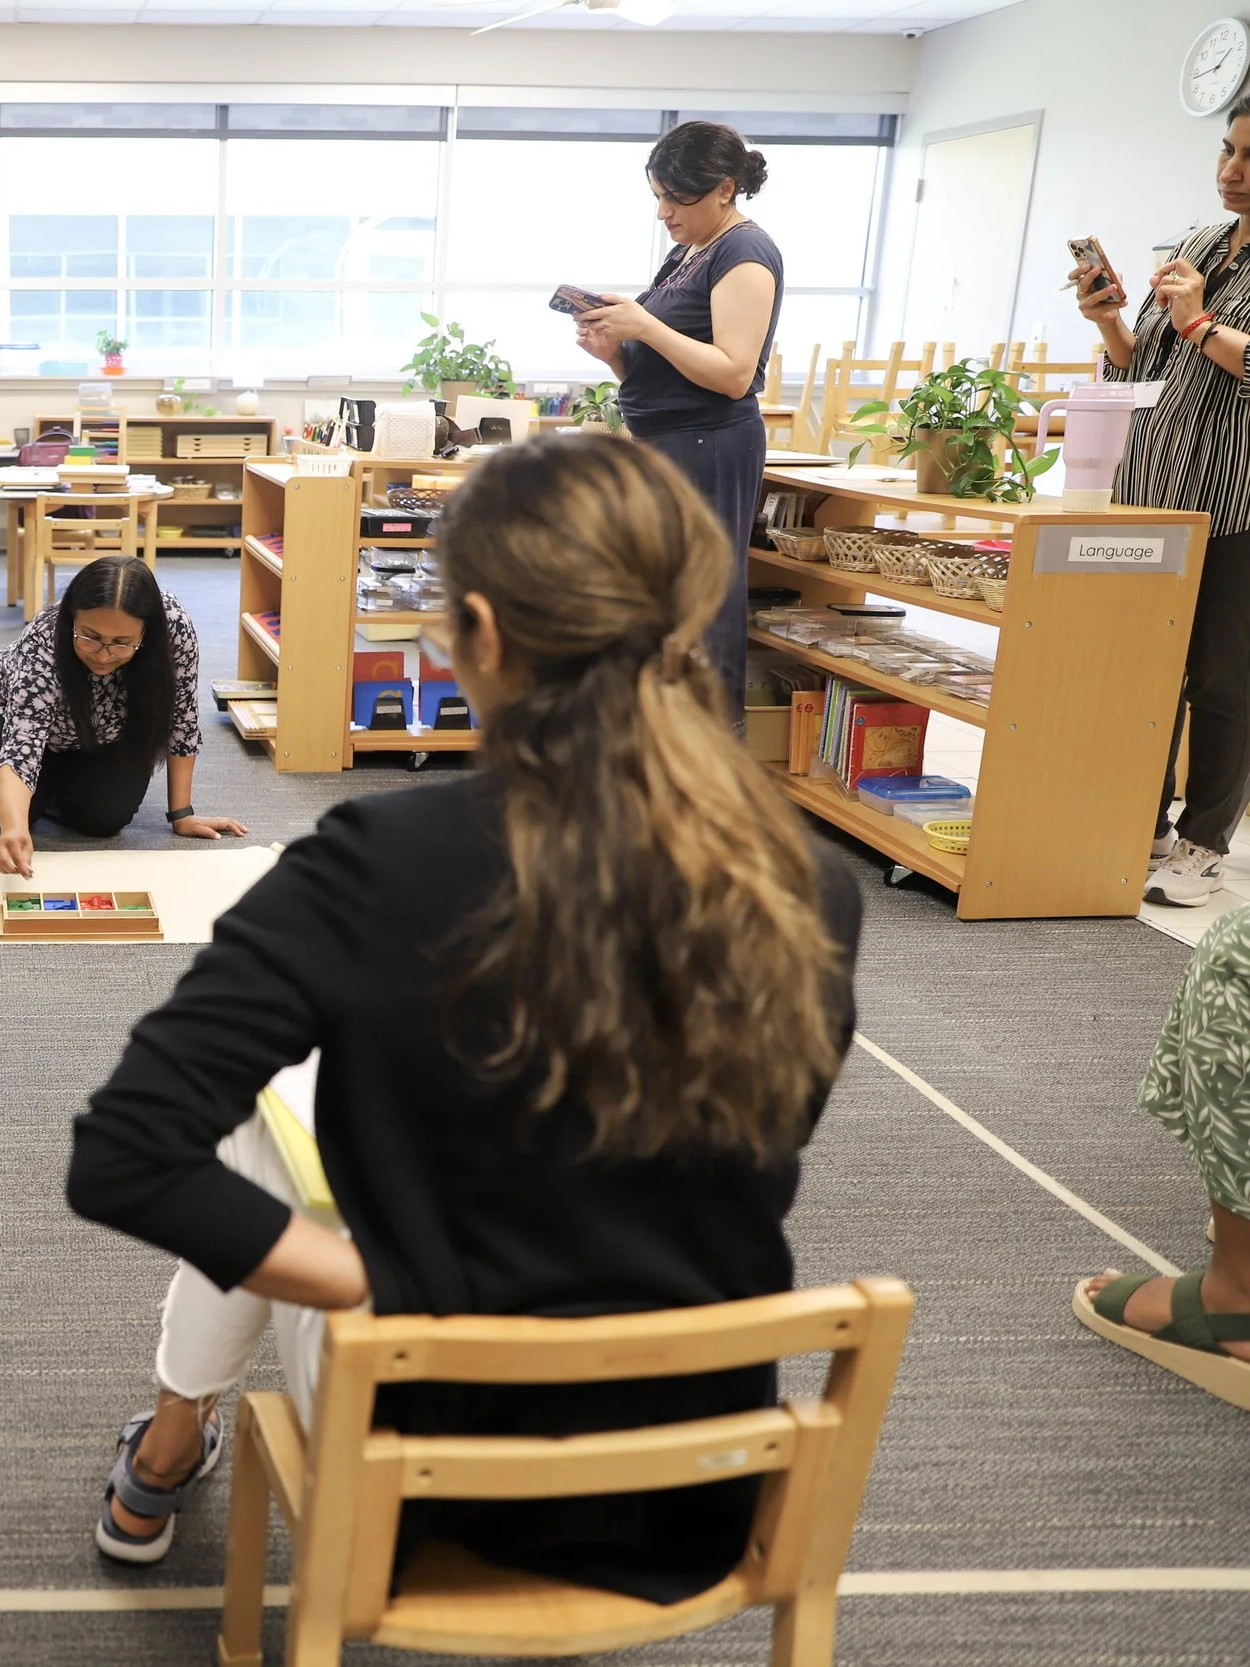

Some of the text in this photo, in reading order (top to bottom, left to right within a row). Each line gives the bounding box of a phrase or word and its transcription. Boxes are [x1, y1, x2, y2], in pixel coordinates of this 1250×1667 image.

[1220, 30, 1229, 40] 12
[1233, 32, 1237, 41] 1
[1210, 38, 1217, 48] 11
[1238, 40, 1244, 51] 2
[1200, 50, 1208, 60] 10
[1193, 84, 1199, 94] 8
[1220, 87, 1227, 97] 5
[1199, 91, 1205, 103] 7
[1210, 94, 1215, 104] 6
[1079, 544, 1154, 560] Language
